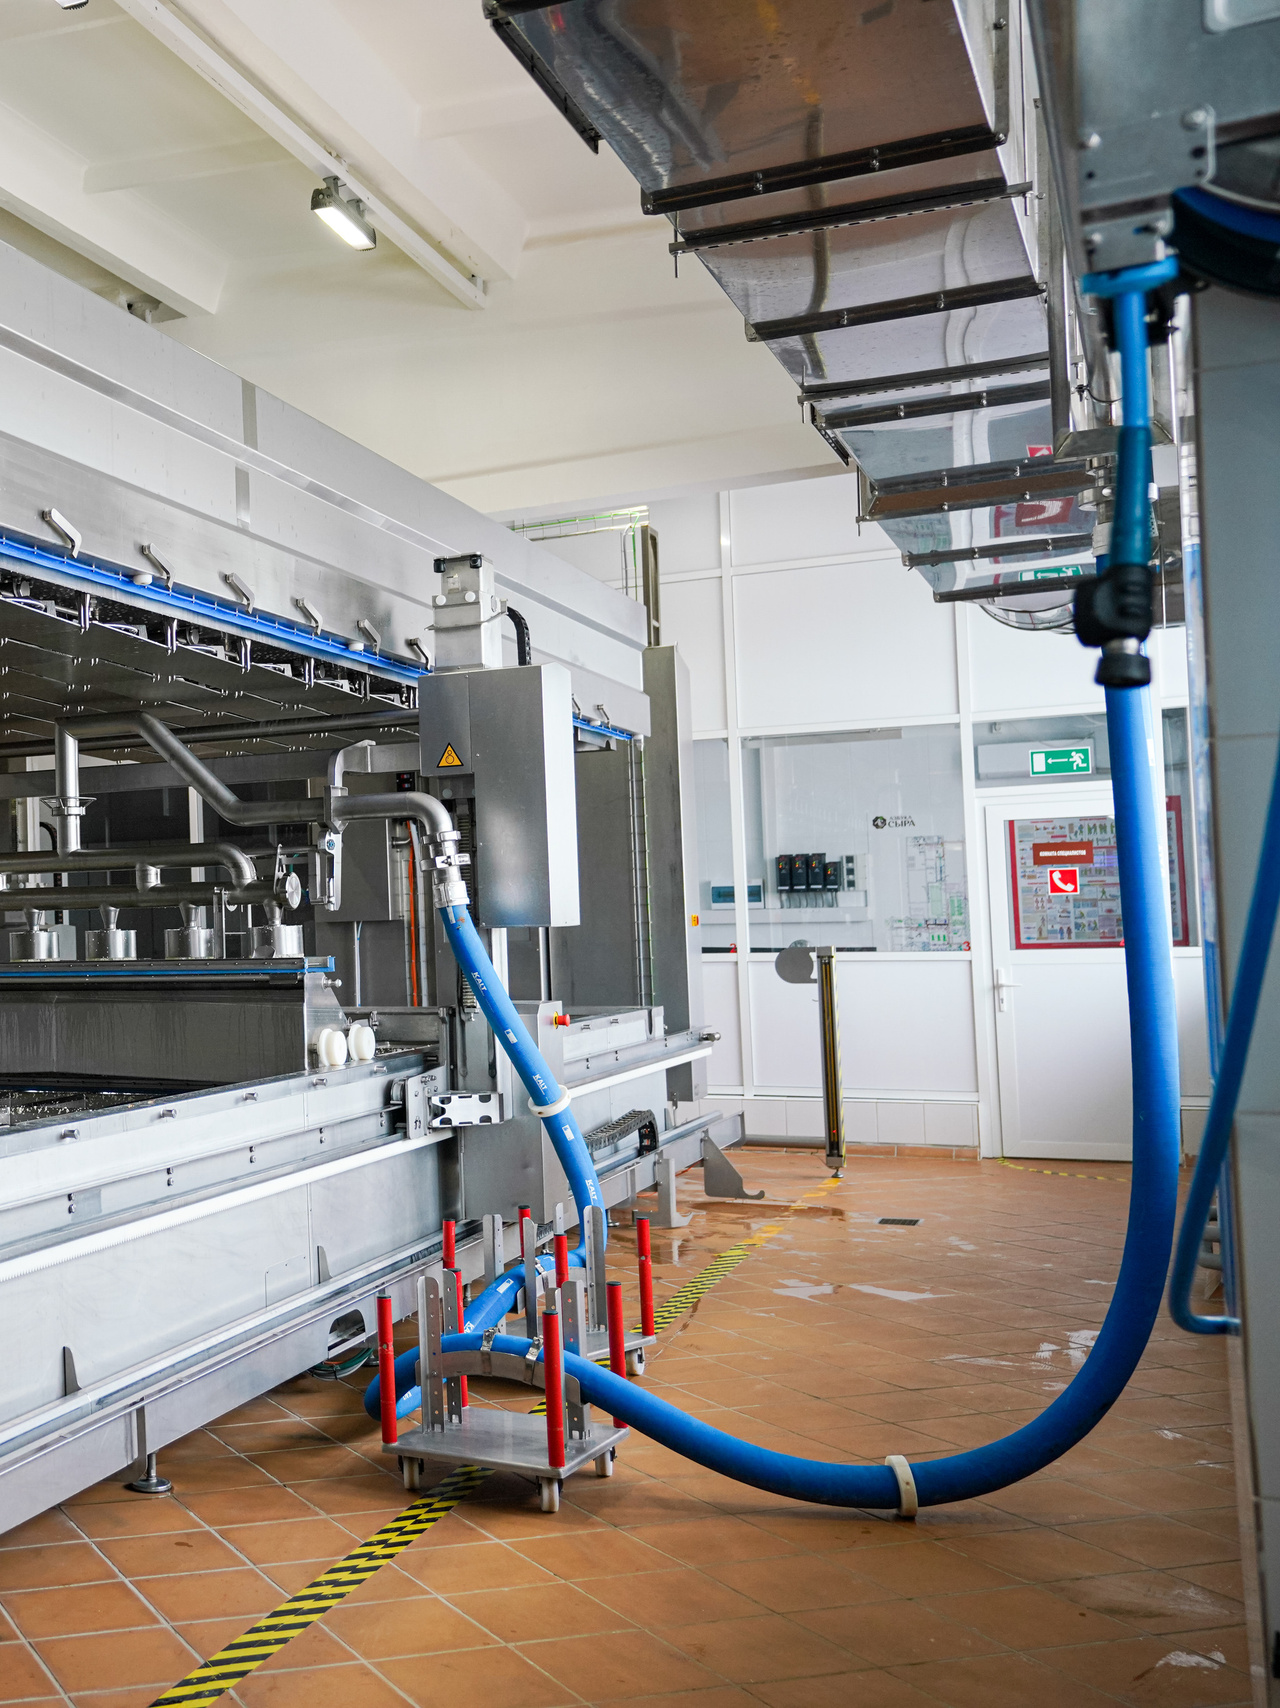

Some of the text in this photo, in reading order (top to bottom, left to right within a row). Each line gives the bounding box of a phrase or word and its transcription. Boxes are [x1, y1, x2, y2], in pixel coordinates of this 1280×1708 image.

[888, 819, 916, 828] СЫРА
[963, 941, 971, 951] 3
[472, 971, 487, 991] KALT
[534, 1073, 548, 1090] KALT
[586, 1179, 598, 1200] KALT
